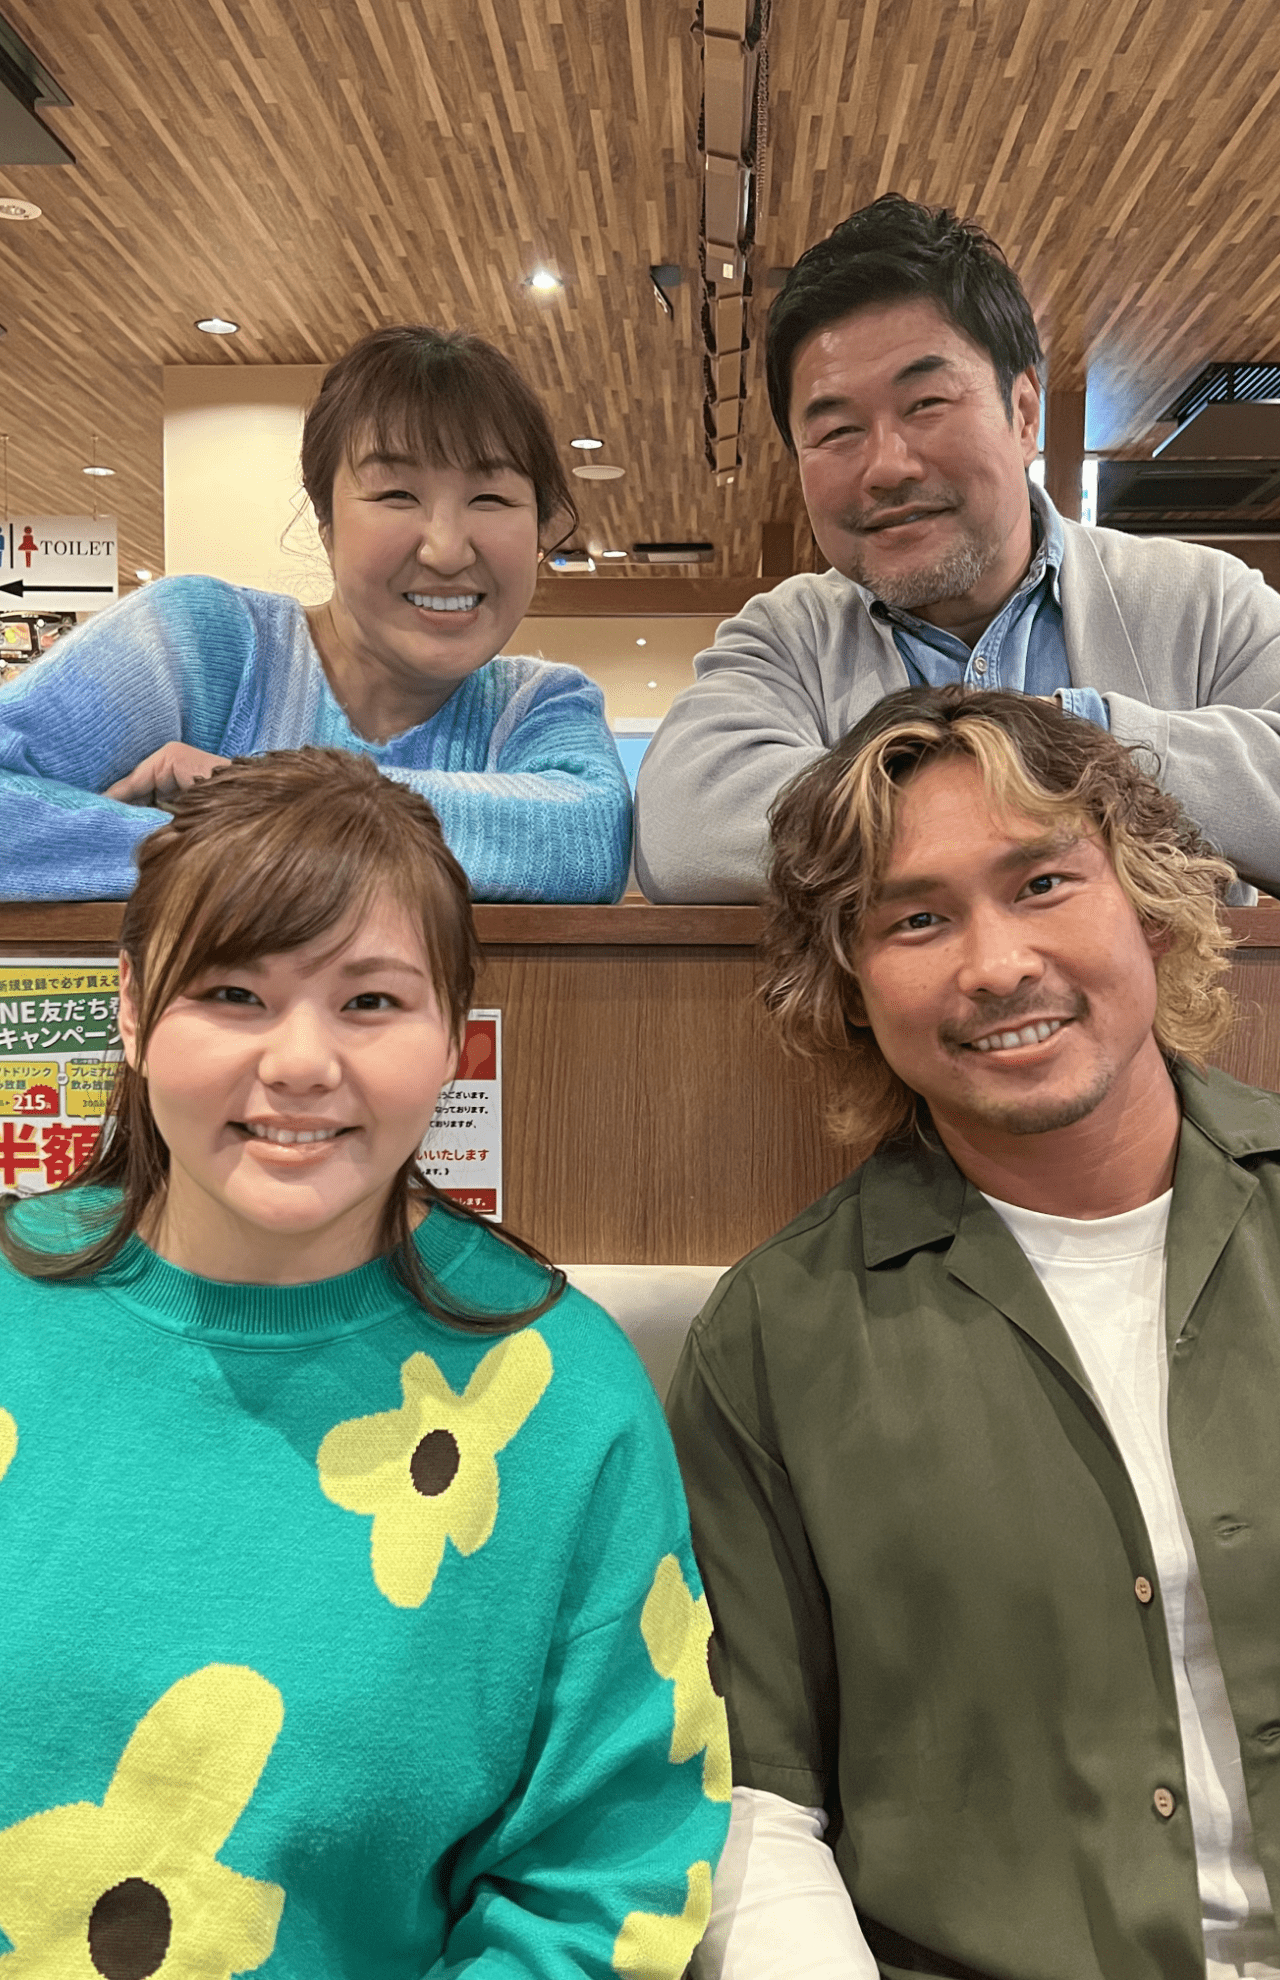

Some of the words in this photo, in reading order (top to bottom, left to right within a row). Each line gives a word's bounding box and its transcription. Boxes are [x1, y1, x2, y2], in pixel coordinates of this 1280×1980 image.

[40, 540, 115, 556] TOILET
[0, 1066, 51, 1078] トドリンク
